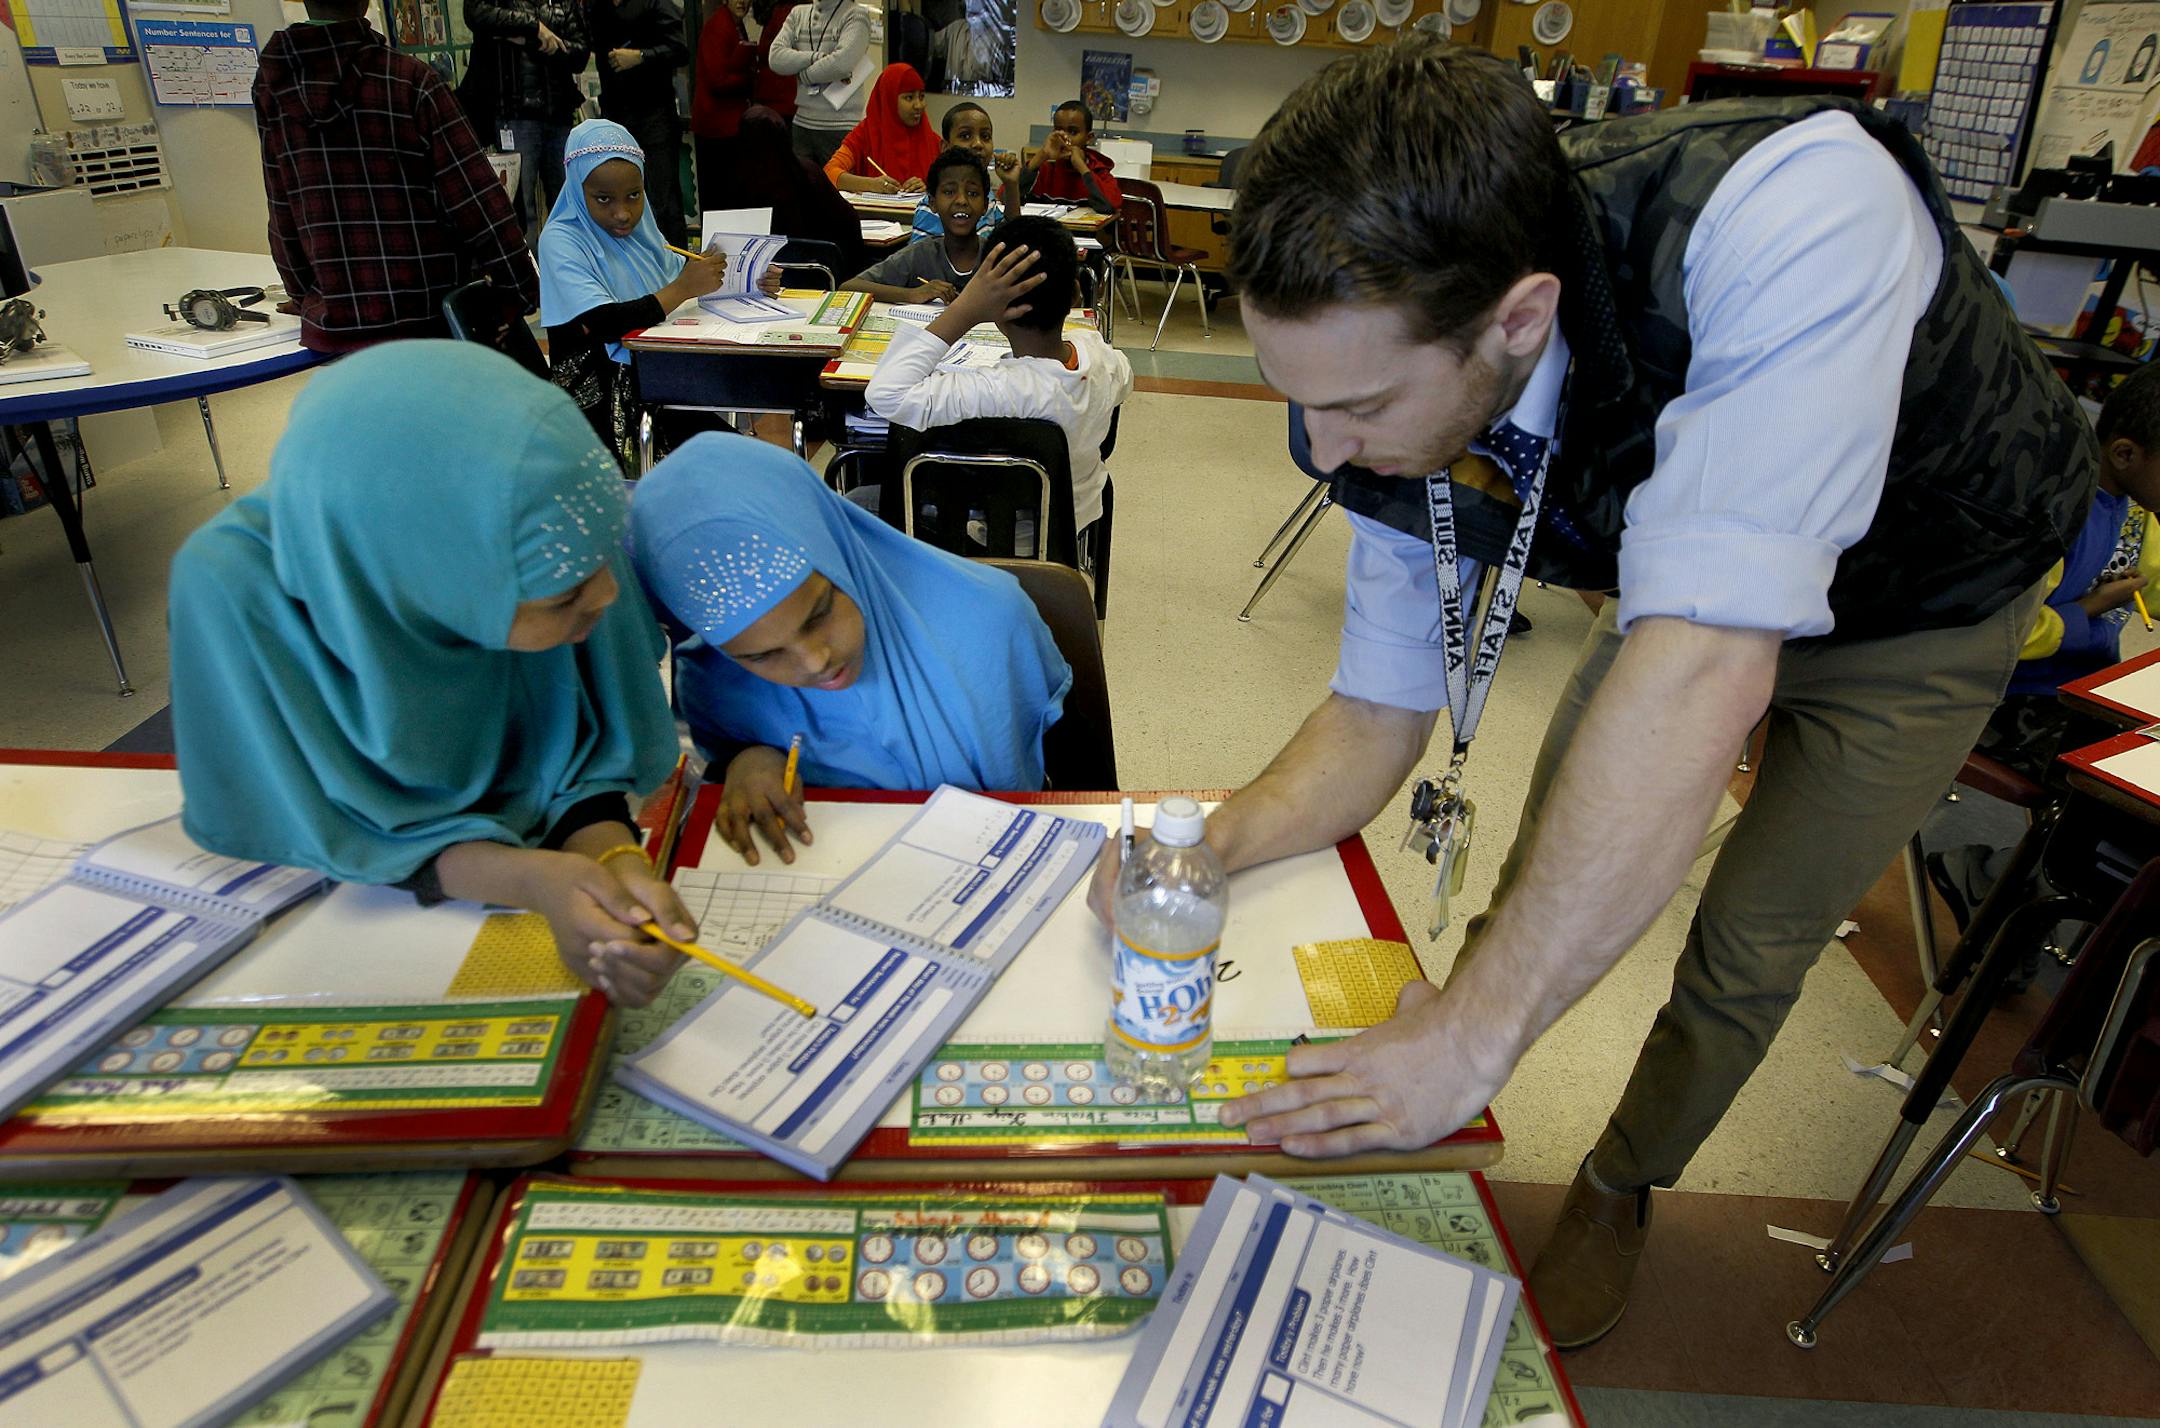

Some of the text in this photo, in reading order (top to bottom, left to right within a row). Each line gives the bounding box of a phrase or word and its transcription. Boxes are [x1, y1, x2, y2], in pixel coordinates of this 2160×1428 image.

[145, 28, 177, 36] Number
[179, 29, 218, 38] Sentences
[219, 30, 231, 38] for
[71, 82, 88, 90] Today
[1275, 1295, 1307, 1362] Today's Problem
[1297, 1352, 1311, 1373] Clint
[1305, 1322, 1322, 1352] makes
[1318, 1287, 1334, 1314] paper
[1313, 1357, 1328, 1378] Then
[1326, 1313, 1341, 1343] makes
[1346, 1256, 1359, 1276] How
[1330, 1249, 1377, 1387] many paper airplanes does Clint
[1195, 1403, 1208, 1420] the
[1204, 1377, 1218, 1401] week
[1214, 1359, 1226, 1377] was
[1222, 1310, 1242, 1359] yesterday?
[1344, 1343, 1366, 1394] have now?
